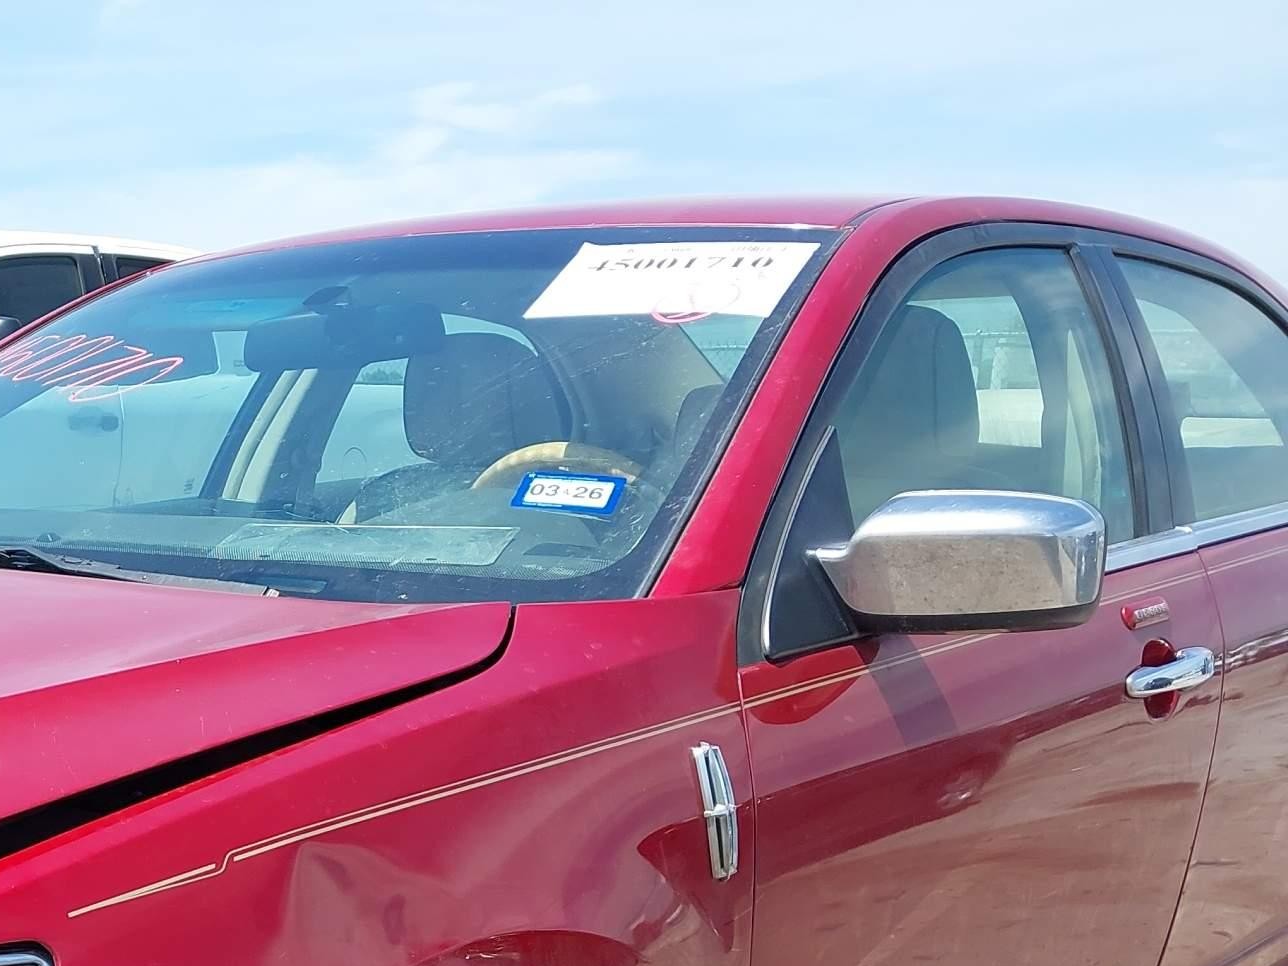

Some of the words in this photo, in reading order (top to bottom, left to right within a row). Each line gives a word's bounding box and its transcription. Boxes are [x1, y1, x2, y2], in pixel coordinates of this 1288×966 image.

[587, 256, 775, 271] 45001710
[529, 483, 561, 497] 03
[572, 486, 604, 499] 26
